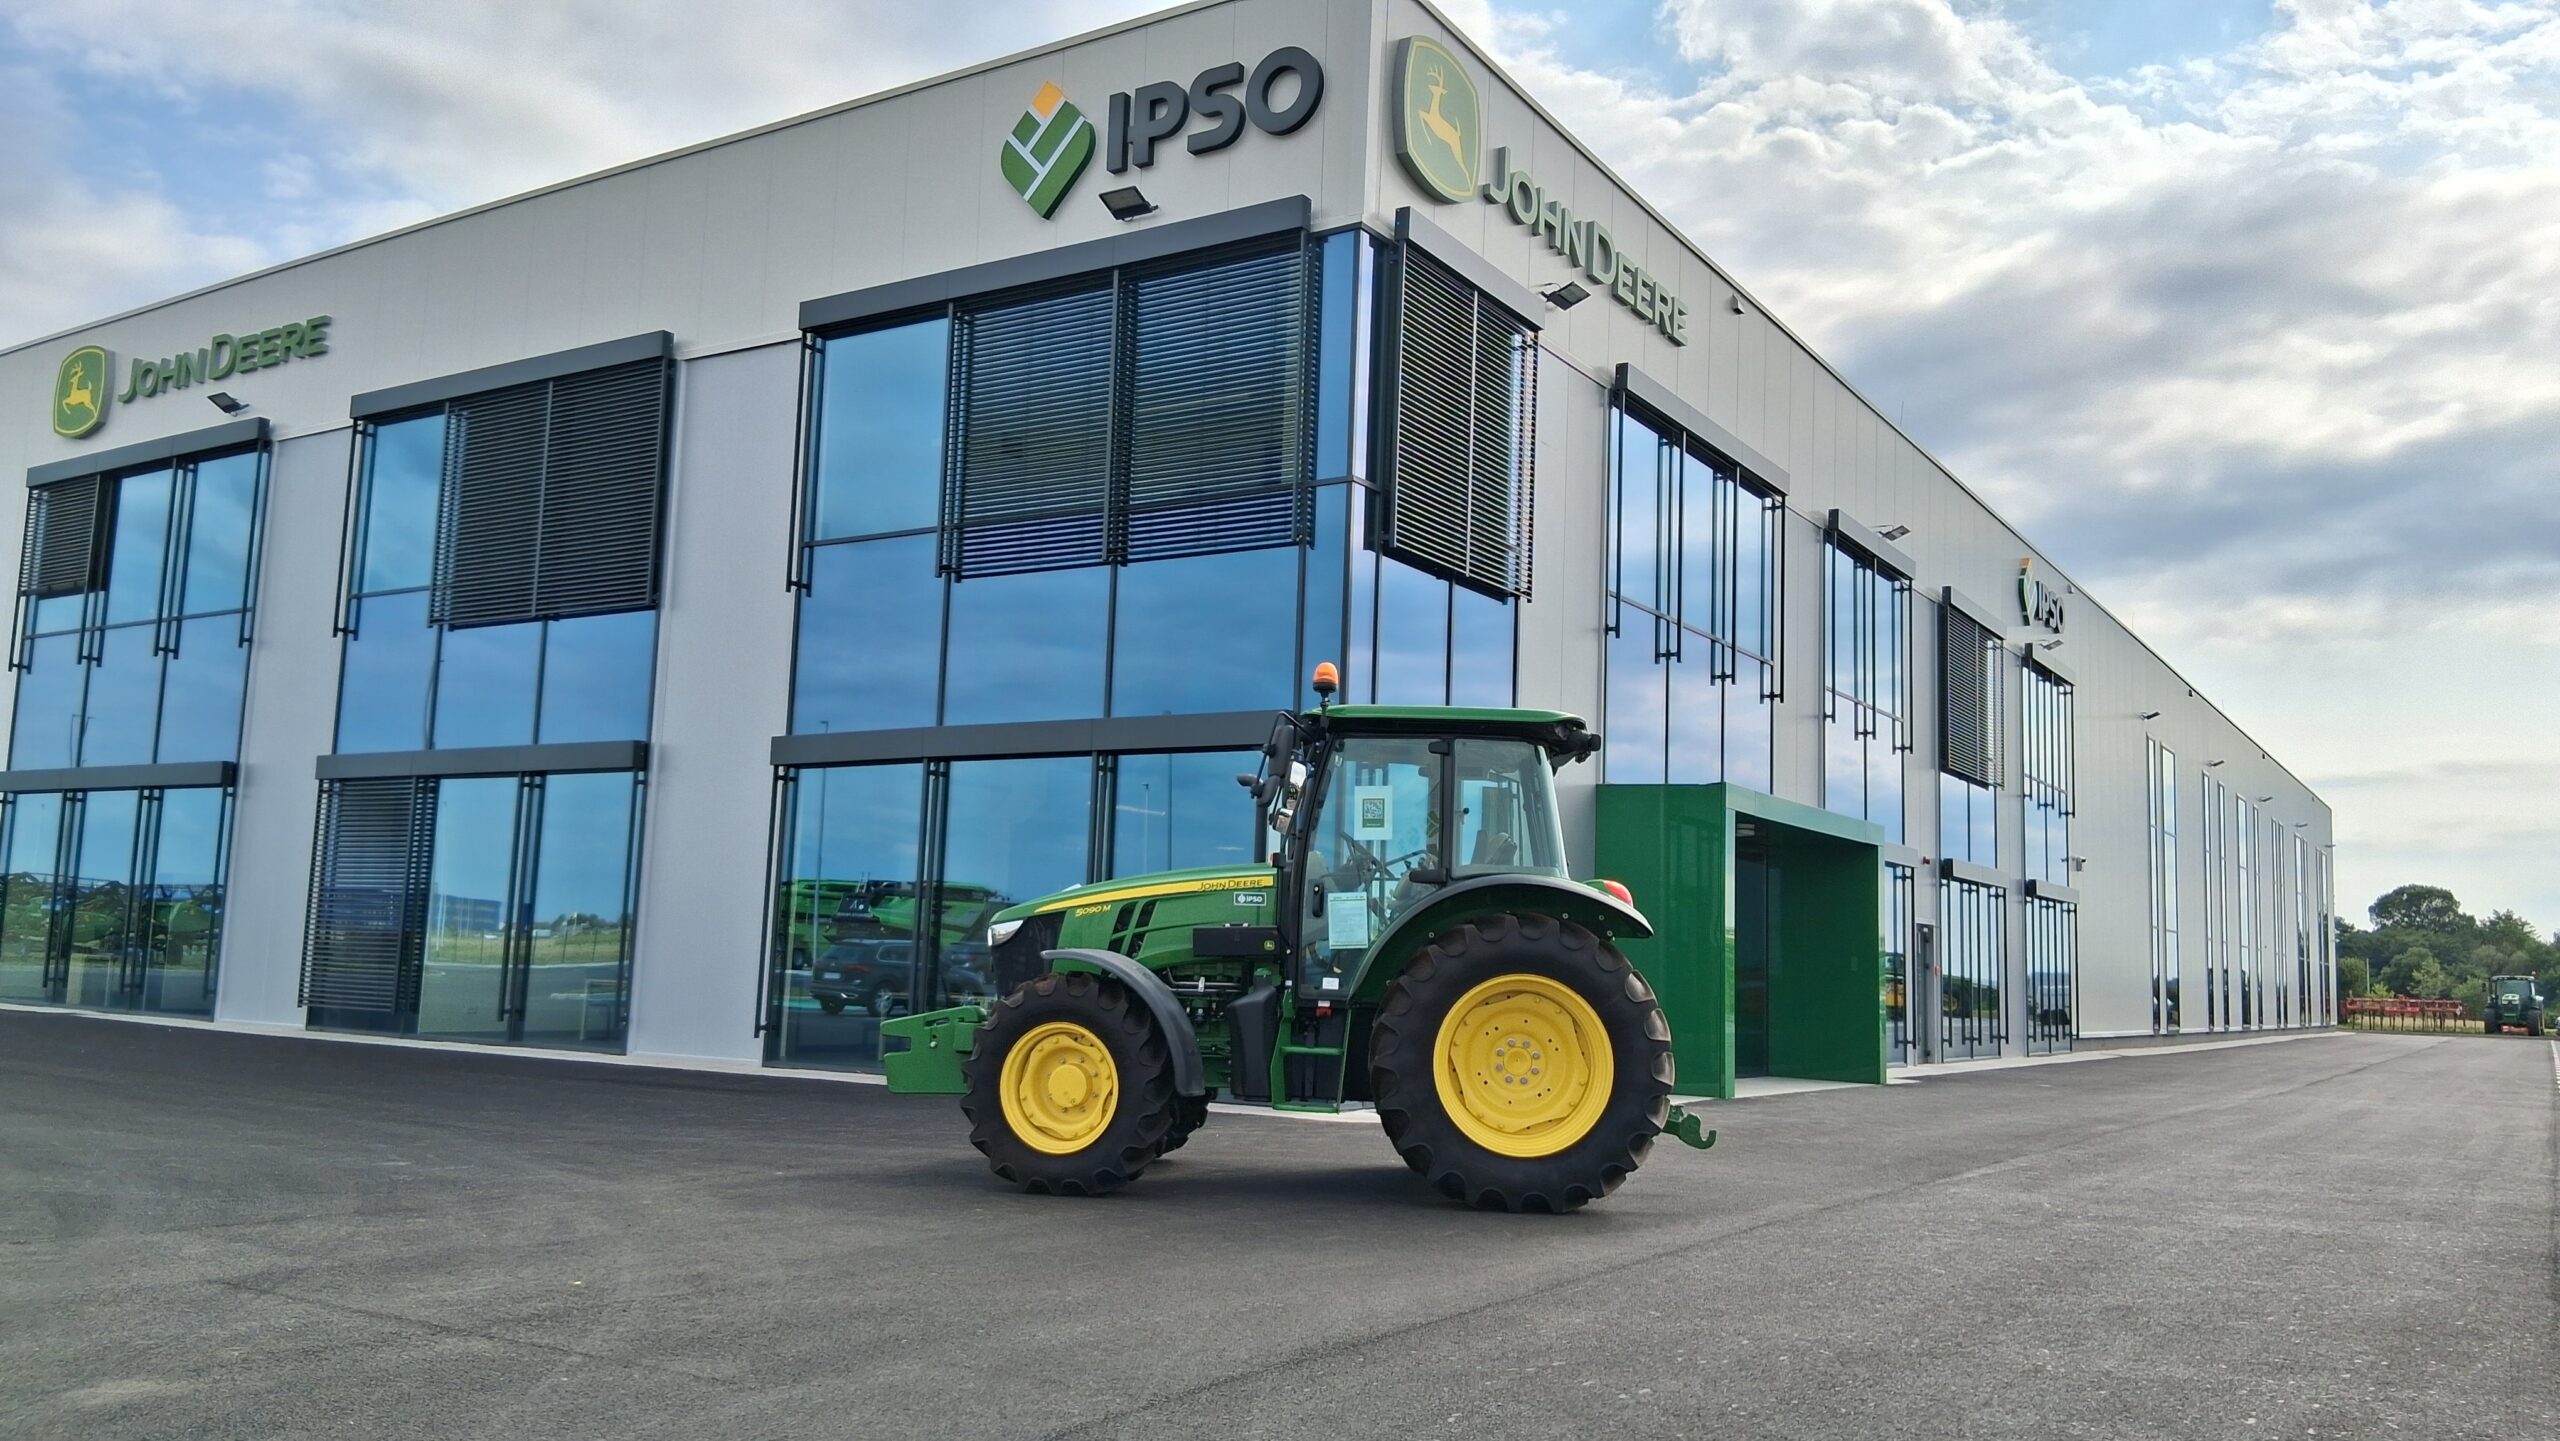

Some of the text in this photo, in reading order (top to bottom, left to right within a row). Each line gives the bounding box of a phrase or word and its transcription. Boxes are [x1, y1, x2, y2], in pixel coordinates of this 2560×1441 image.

[1106, 46, 1325, 175] IPSO
[1483, 146, 1688, 347] JOHN DEERE
[117, 314, 332, 404] JOHN DEERE
[2034, 580, 2065, 634] IPSO
[1075, 904, 1112, 917] 5090 M
[1198, 879, 1264, 890] JOHN DEERE
[1246, 895, 1263, 903] IPSO
